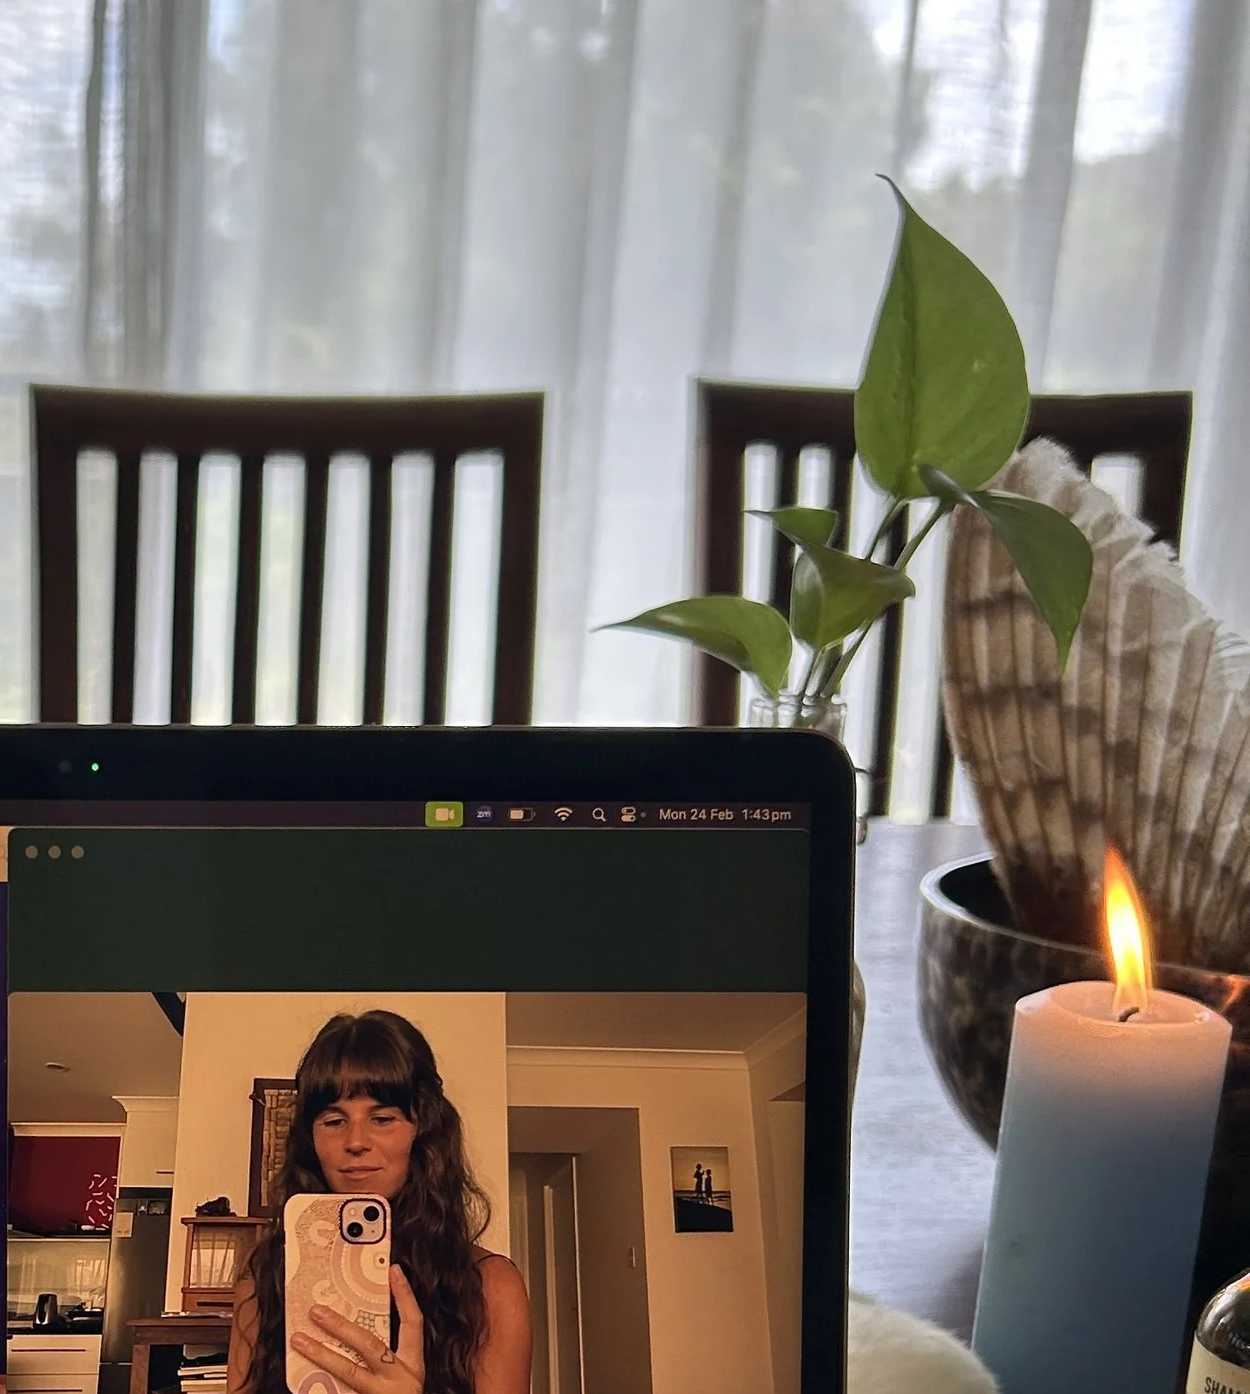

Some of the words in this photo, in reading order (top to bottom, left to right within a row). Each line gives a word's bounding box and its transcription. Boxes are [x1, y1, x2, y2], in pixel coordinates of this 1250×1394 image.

[659, 808, 686, 820] Mon
[690, 808, 707, 820] 24
[710, 808, 734, 820] Feb
